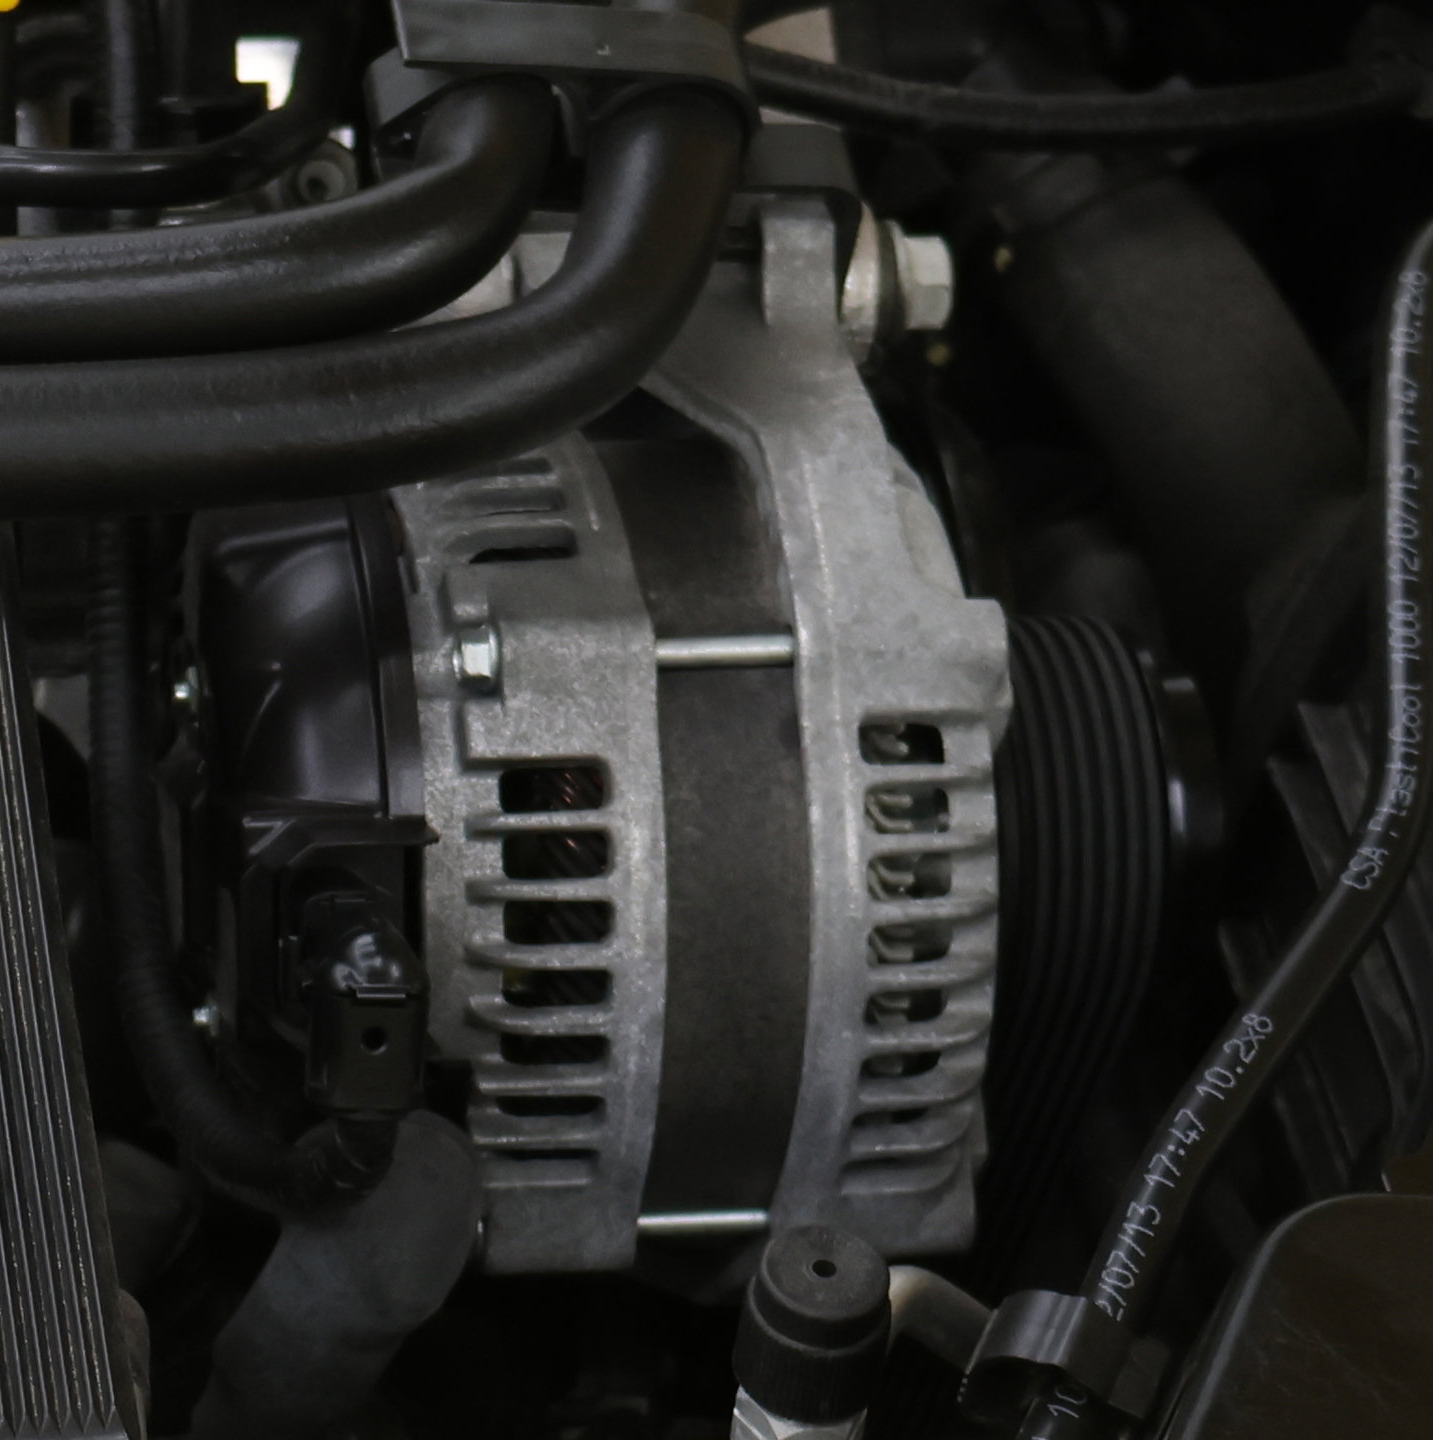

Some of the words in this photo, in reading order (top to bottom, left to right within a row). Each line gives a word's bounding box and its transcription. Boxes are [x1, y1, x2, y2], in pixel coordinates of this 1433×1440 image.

[1388, 600, 1421, 663] 1000
[1144, 1109, 1205, 1188] 17:47
[1195, 1013, 1273, 1100] 10.2x8
